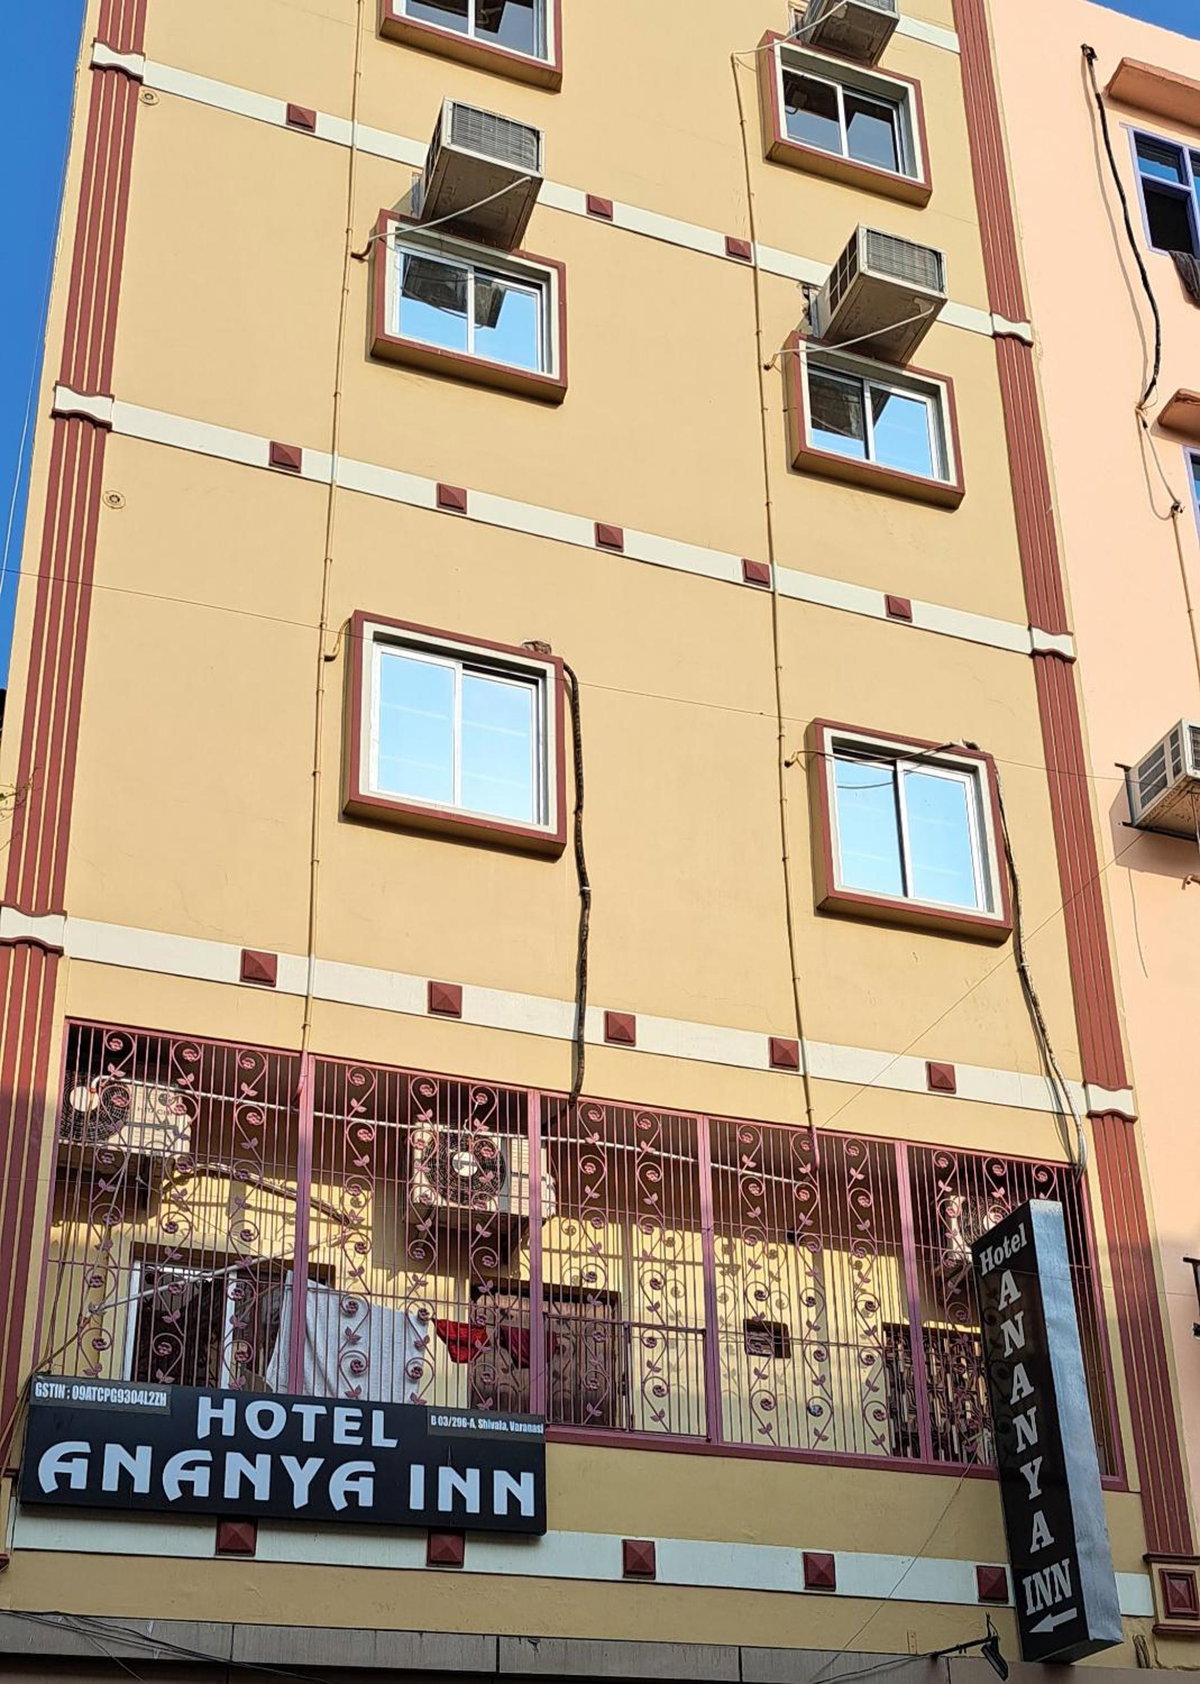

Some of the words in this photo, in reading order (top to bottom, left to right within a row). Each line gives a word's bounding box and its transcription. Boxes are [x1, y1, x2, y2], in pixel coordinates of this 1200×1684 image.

[979, 1223, 1028, 1276] Hotel
[35, 1382, 66, 1399] GSTIN
[998, 1270, 1055, 1554] ANANYA
[197, 1396, 399, 1448] HOTEL
[430, 1415, 437, 1426] B
[509, 1420, 544, 1434] Varanasi
[38, 1441, 376, 1511] ANANYA
[409, 1464, 535, 1517] INN
[1022, 1558, 1073, 1616] INN
